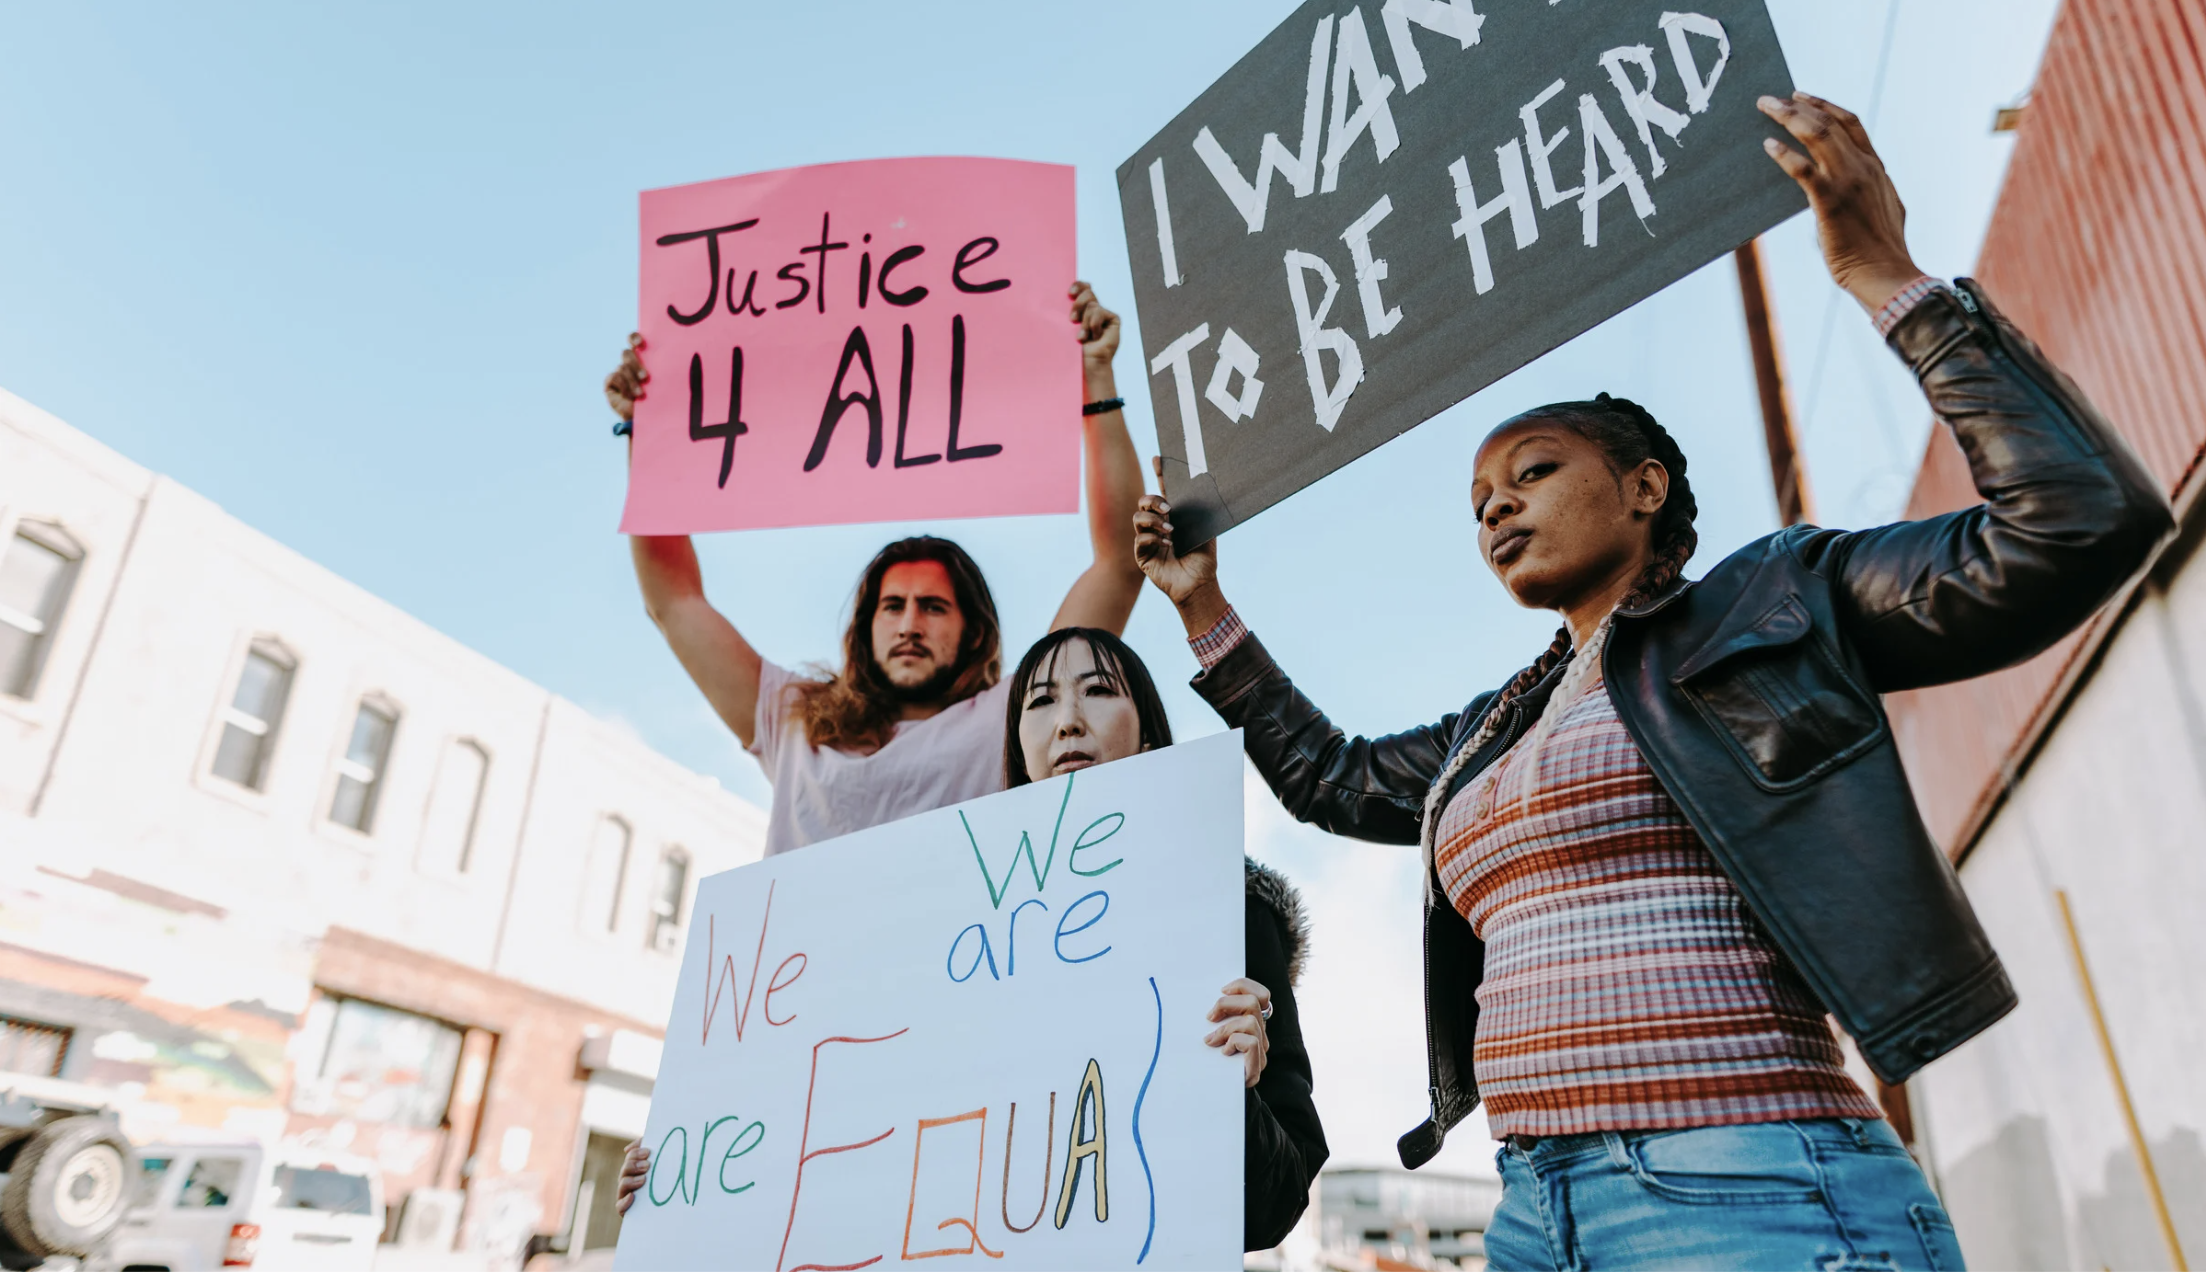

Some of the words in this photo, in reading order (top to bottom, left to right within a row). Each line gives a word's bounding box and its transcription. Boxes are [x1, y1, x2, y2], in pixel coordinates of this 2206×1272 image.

[1149, 157, 1184, 289] I
[1193, 0, 1561, 234] WAN
[656, 211, 1012, 327] Justice
[1151, 322, 1264, 479] TO
[1284, 194, 1404, 433] BE
[1447, 11, 1731, 295] HEARD
[688, 346, 749, 489] 4
[803, 314, 1003, 473] ALL
[958, 771, 1125, 910] We
[702, 879, 808, 1047] We
[947, 890, 1112, 983] are
[648, 1115, 766, 1207] are
